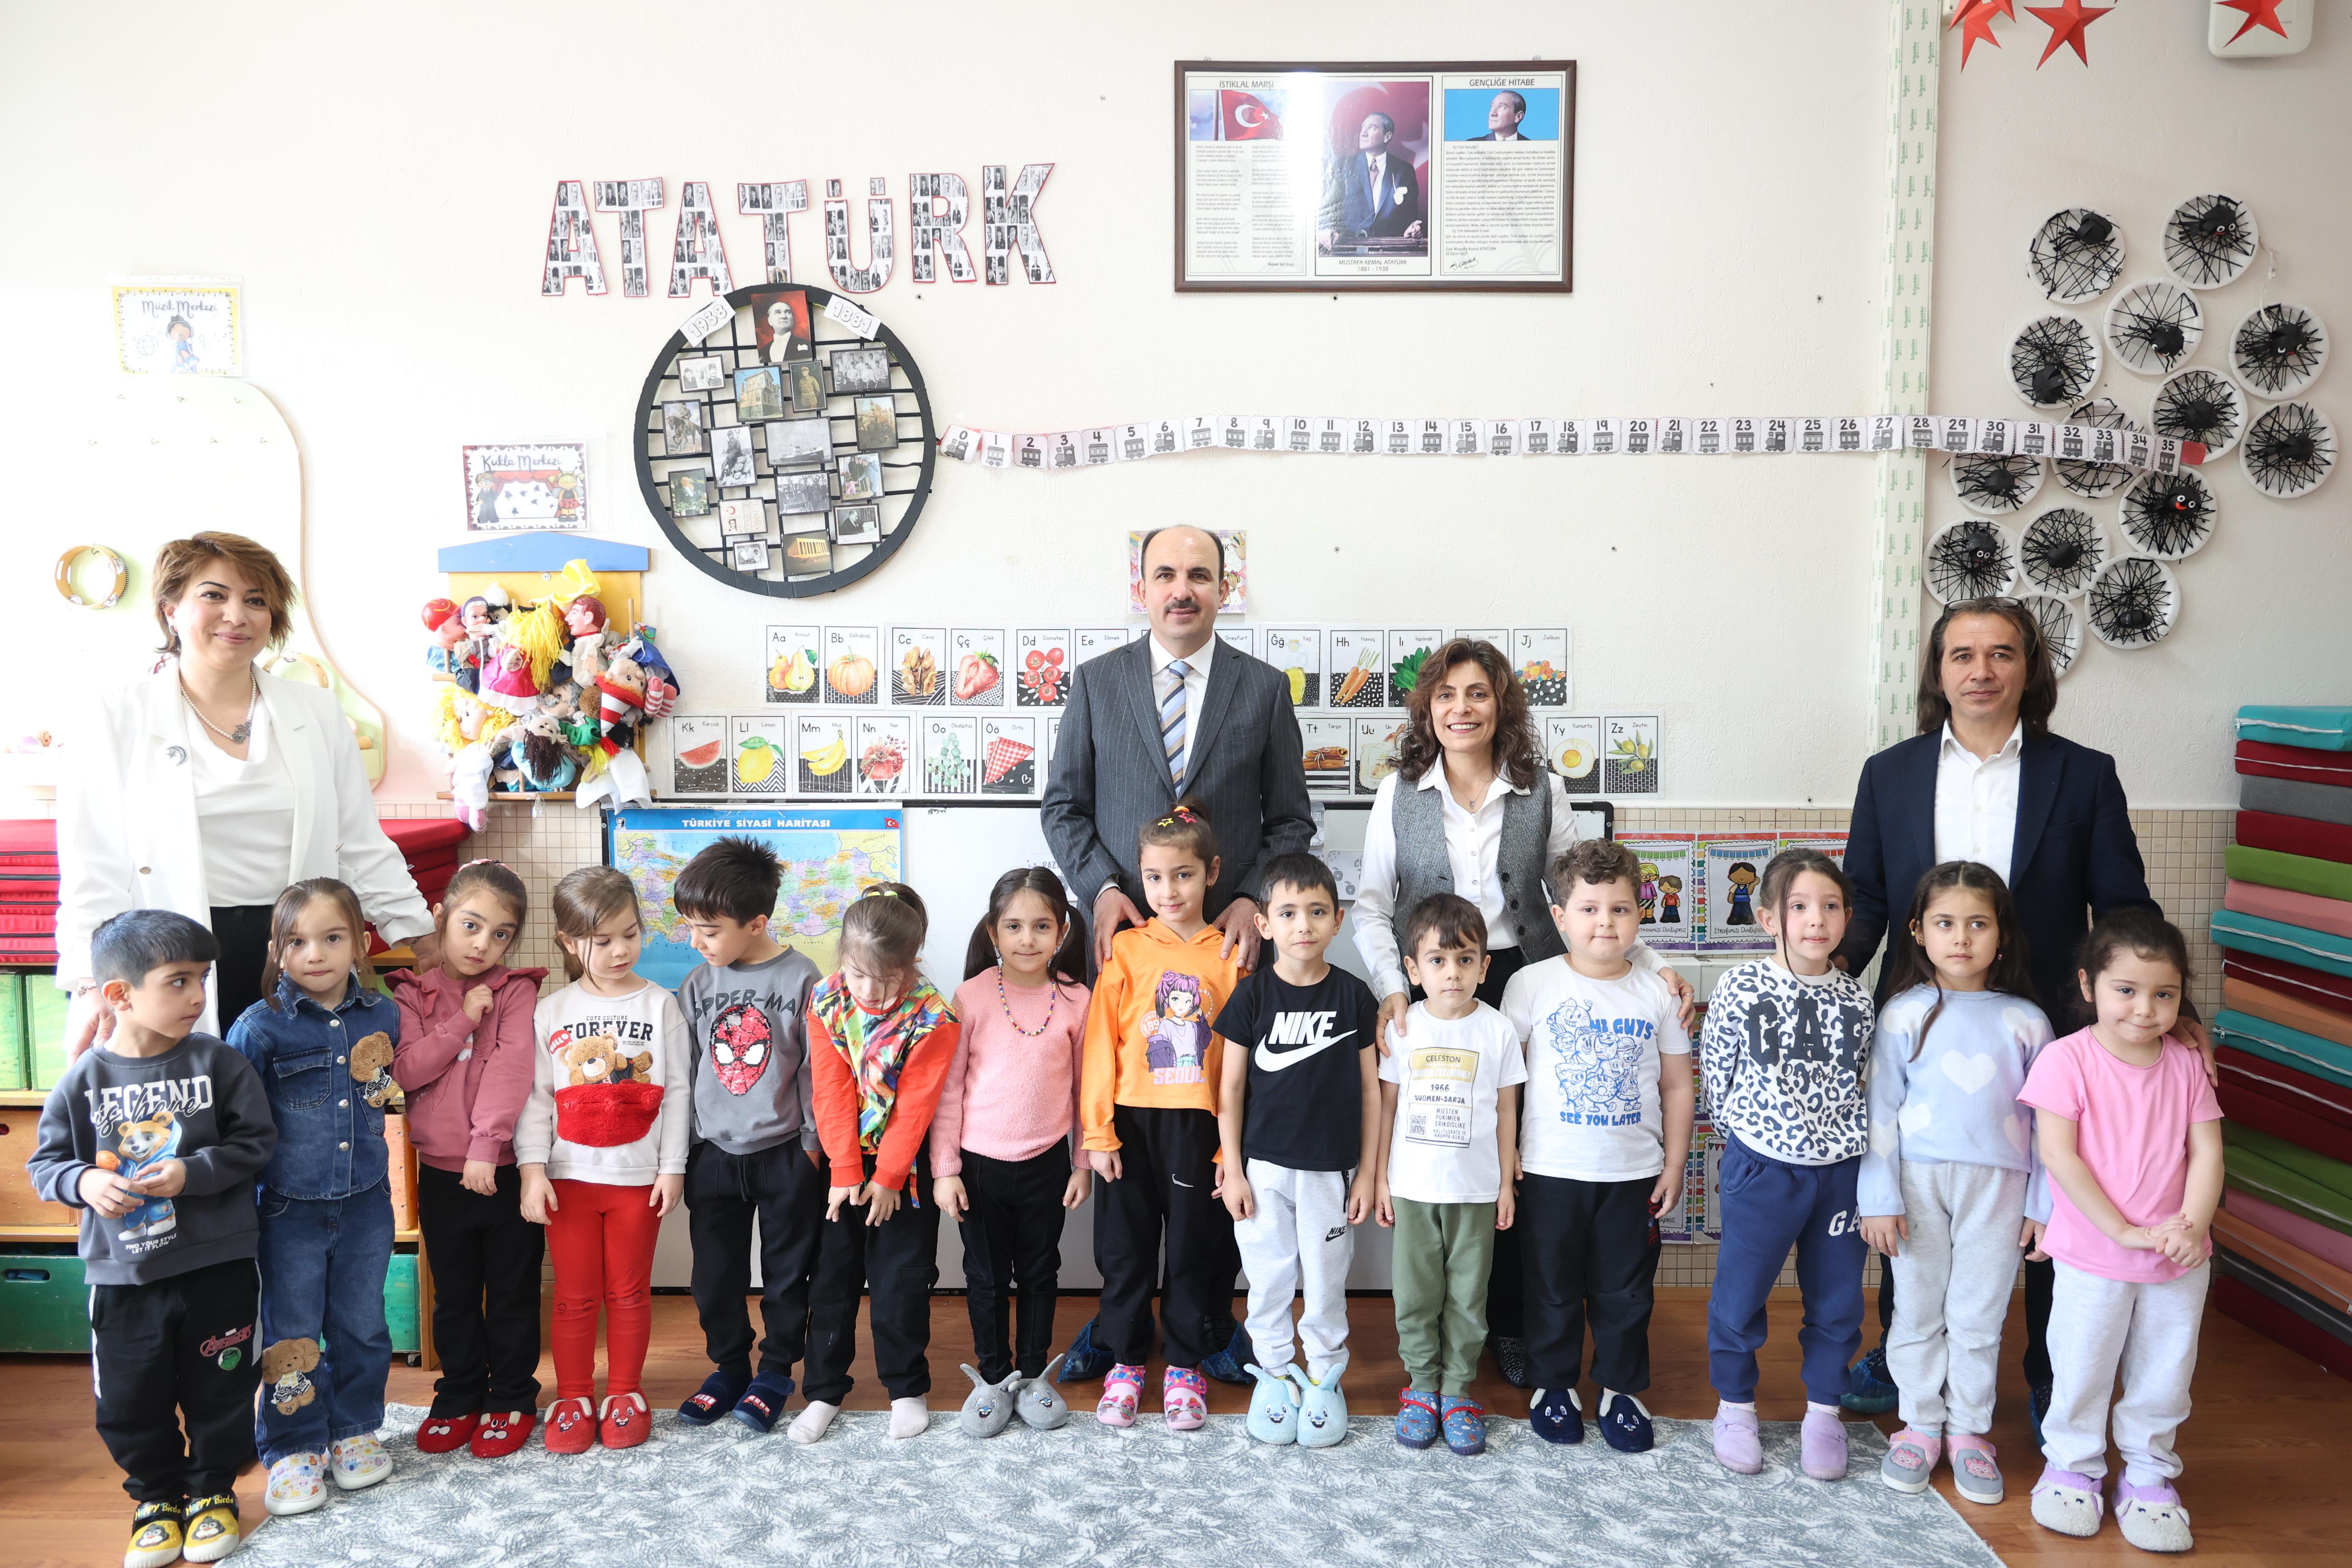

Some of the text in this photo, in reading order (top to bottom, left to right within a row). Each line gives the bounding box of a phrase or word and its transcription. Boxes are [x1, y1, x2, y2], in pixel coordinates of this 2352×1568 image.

[1219, 79, 1274, 90] İSTİKLAL MARŞI
[1470, 77, 1535, 88] GENÇLİĞE HİTABE
[541, 162, 1055, 298] ATATÜRK
[141, 300, 218, 318] Müzik Merkezi
[688, 303, 728, 338] 1938
[832, 301, 873, 336] 1881
[1161, 421, 1169, 432] 6
[1195, 417, 1203, 427] 7
[1231, 417, 1238, 428] 8
[1262, 419, 1270, 429] 9
[1295, 419, 1306, 430] 10
[1327, 419, 1334, 430] 11
[1358, 420, 1370, 432] 12
[1392, 421, 1404, 433] 13
[1425, 420, 1437, 432] 14
[1461, 422, 1472, 432] 15
[1531, 420, 1542, 431] 17
[1564, 421, 1575, 432] 18
[1596, 420, 1608, 431] 19
[1630, 420, 1647, 432] 20
[1668, 419, 1682, 432] 21
[1701, 420, 1718, 432] 22
[1736, 419, 1752, 431] 23
[1769, 419, 1786, 432] 24
[1804, 419, 1821, 430] 25
[1840, 419, 1857, 430] 26
[1876, 417, 1893, 430] 27
[1913, 417, 1930, 428] 28
[1949, 419, 1967, 430] 29
[1986, 420, 2005, 433] 30
[1127, 426, 1136, 437] 5
[1496, 423, 1507, 434] 16
[2028, 423, 2040, 434] 31
[2064, 425, 2081, 438] 32
[959, 430, 968, 440] 0
[995, 434, 997, 445] 1
[1060, 434, 1069, 446] 3
[1093, 431, 1102, 442] 4
[2097, 428, 2114, 441] 33
[2132, 432, 2147, 447] 34
[1026, 436, 1035, 447] 2
[2161, 439, 2175, 451] 35
[481, 454, 562, 473] Kukla Merkezi
[772, 632, 786, 642] Aa
[831, 633, 844, 643] Bb
[899, 634, 911, 645] Cc
[957, 635, 970, 648] Çç
[1023, 635, 1035, 646] Dd
[1081, 635, 1094, 646] Ee
[1271, 634, 1284, 648] Ğğ
[1336, 637, 1349, 647] Hh
[1521, 635, 1531, 648] Jj
[682, 723, 694, 732] Kk
[740, 723, 748, 732] Ll
[802, 723, 820, 732] Mm
[863, 723, 876, 733] Nn
[933, 723, 946, 733] Oo
[986, 722, 1000, 734] Öö
[1306, 724, 1318, 733] Tt
[1362, 725, 1374, 735] Uu
[1553, 724, 1565, 736] Yy
[1611, 723, 1623, 733] Zz
[682, 817, 831, 827] TÜRKİYE SİYASİ HARİTASI
[563, 1021, 653, 1041] FOREVER
[1268, 1011, 1337, 1044] NIKE
[1613, 1018, 1654, 1040] GUYS
[1748, 997, 1863, 1072] GAP
[549, 1033, 569, 1052] HELLO
[1153, 1066, 1206, 1085] SEOUL
[1430, 1084, 1450, 1092] 1966
[84, 1075, 213, 1124] LEGEND
[1415, 1095, 1465, 1104] SUOMEN-SARJA
[96, 1087, 201, 1138] is here
[1560, 1111, 1641, 1126] SEE YOU LATER
[1827, 1206, 1861, 1237] GA
[1329, 1226, 1346, 1236] NIKE
[141, 1239, 158, 1248] YOUR
[160, 1233, 177, 1245] STYLE
[151, 1240, 170, 1251] FLOW
[214, 1494, 234, 1504] Birds
[162, 1502, 181, 1514] Birds
